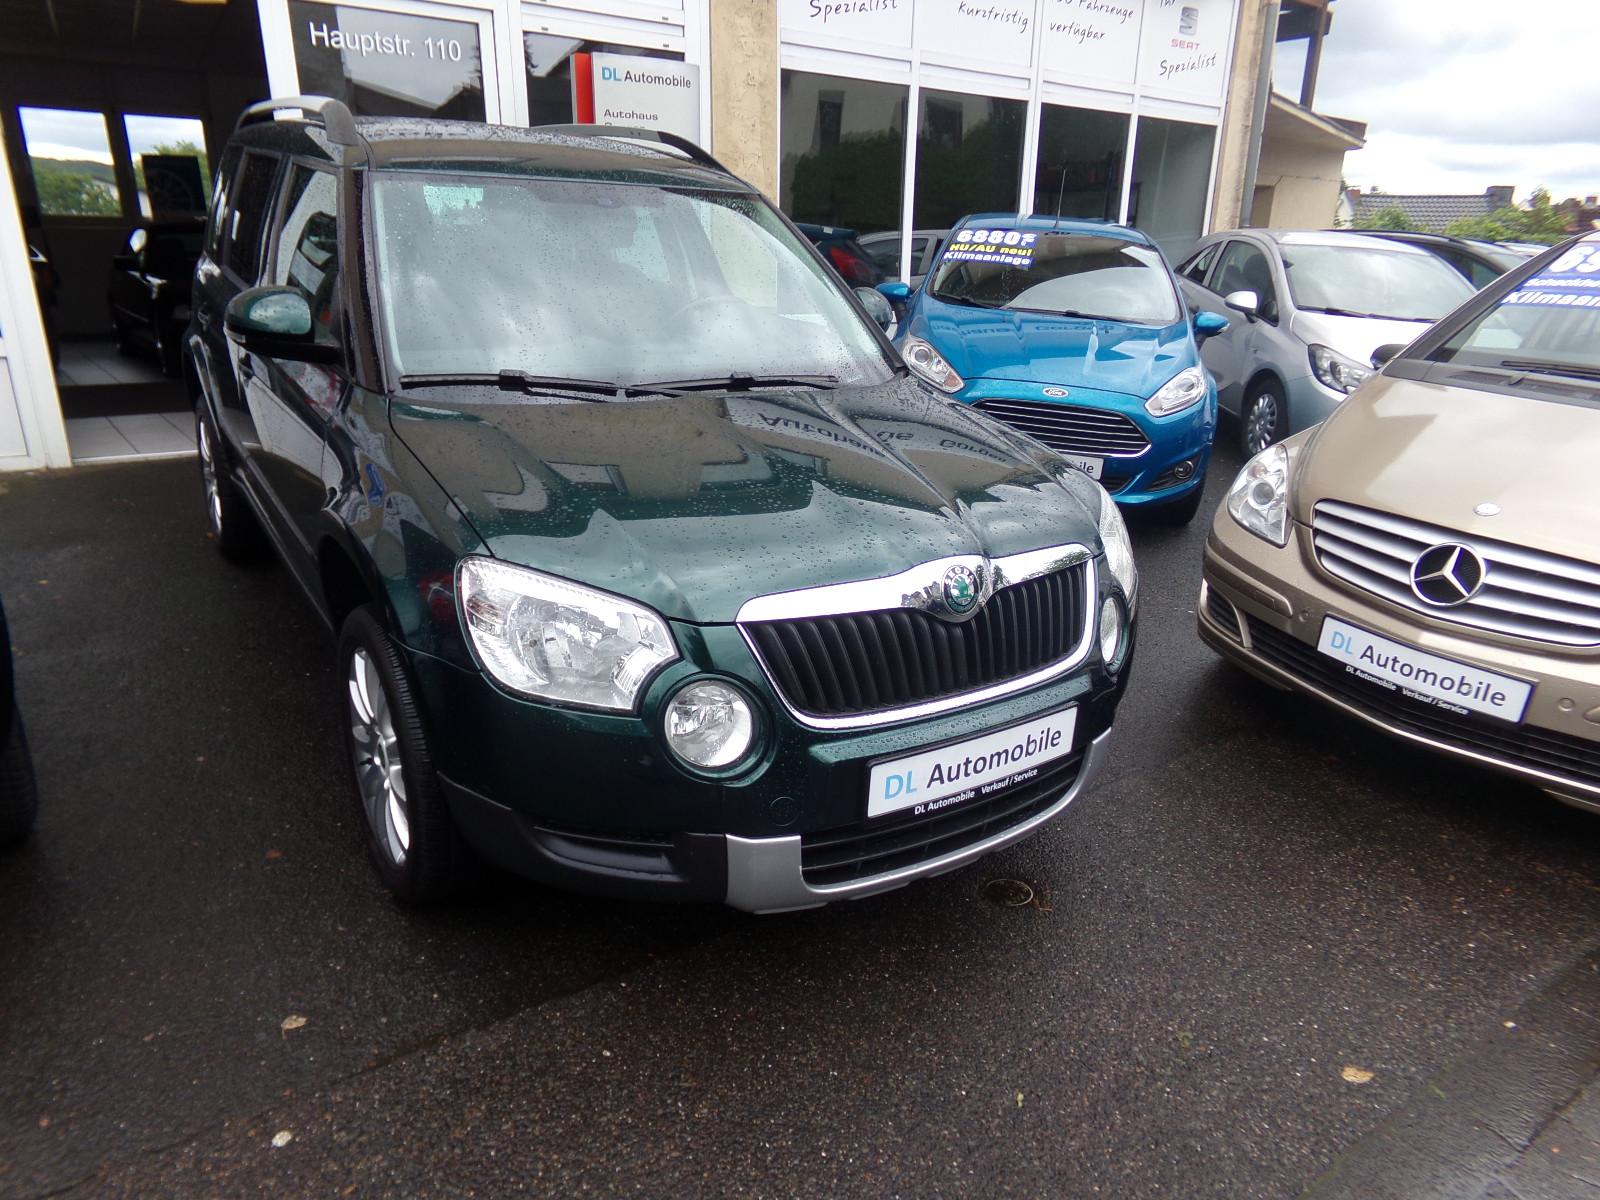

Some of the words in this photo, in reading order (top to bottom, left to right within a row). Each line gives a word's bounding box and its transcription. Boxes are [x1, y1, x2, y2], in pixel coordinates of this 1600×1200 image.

[809, 0, 898, 24] Spezialist
[958, 1, 1029, 34] Kurzfristig
[309, 21, 416, 57] Hauptstr.
[424, 36, 462, 62] 110
[1050, 21, 1107, 44] verfügbar
[1170, 38, 1201, 51] SEAT
[601, 65, 622, 82] DL
[624, 70, 692, 89] Automobile
[1159, 52, 1217, 80] Spezialist
[603, 108, 659, 121] Autohaus
[943, 251, 1031, 266] Klimaanlage
[949, 243, 996, 253] HU/AU
[1330, 631, 1353, 655] DL
[1359, 644, 1507, 707] Automobile
[1345, 665, 1355, 674] DL
[1355, 672, 1397, 690] Automobile
[884, 770, 918, 800] DL
[926, 727, 1062, 789] Automobile
[914, 805, 926, 815] DL
[927, 790, 975, 811] Automobile
